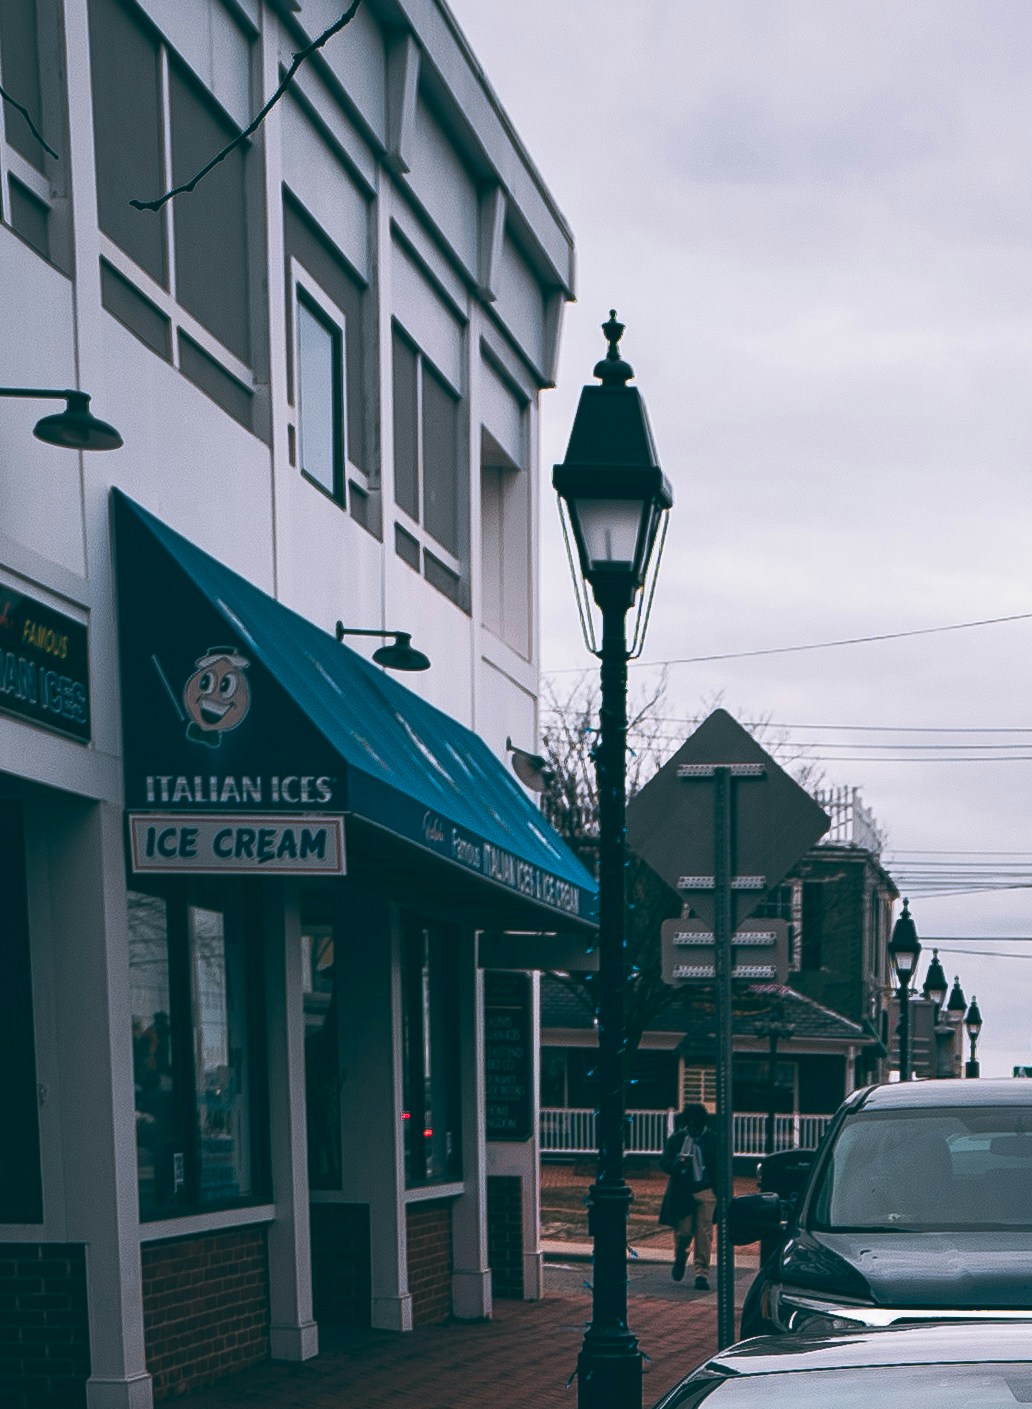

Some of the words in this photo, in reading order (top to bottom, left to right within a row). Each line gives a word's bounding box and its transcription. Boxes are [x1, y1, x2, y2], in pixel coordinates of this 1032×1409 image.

[22, 618, 69, 660] FAMOUS
[40, 666, 87, 724] ICES
[145, 775, 262, 802] ITALIAN
[271, 775, 333, 803] ICES
[145, 826, 199, 858] ICE
[212, 827, 328, 864] CREAM
